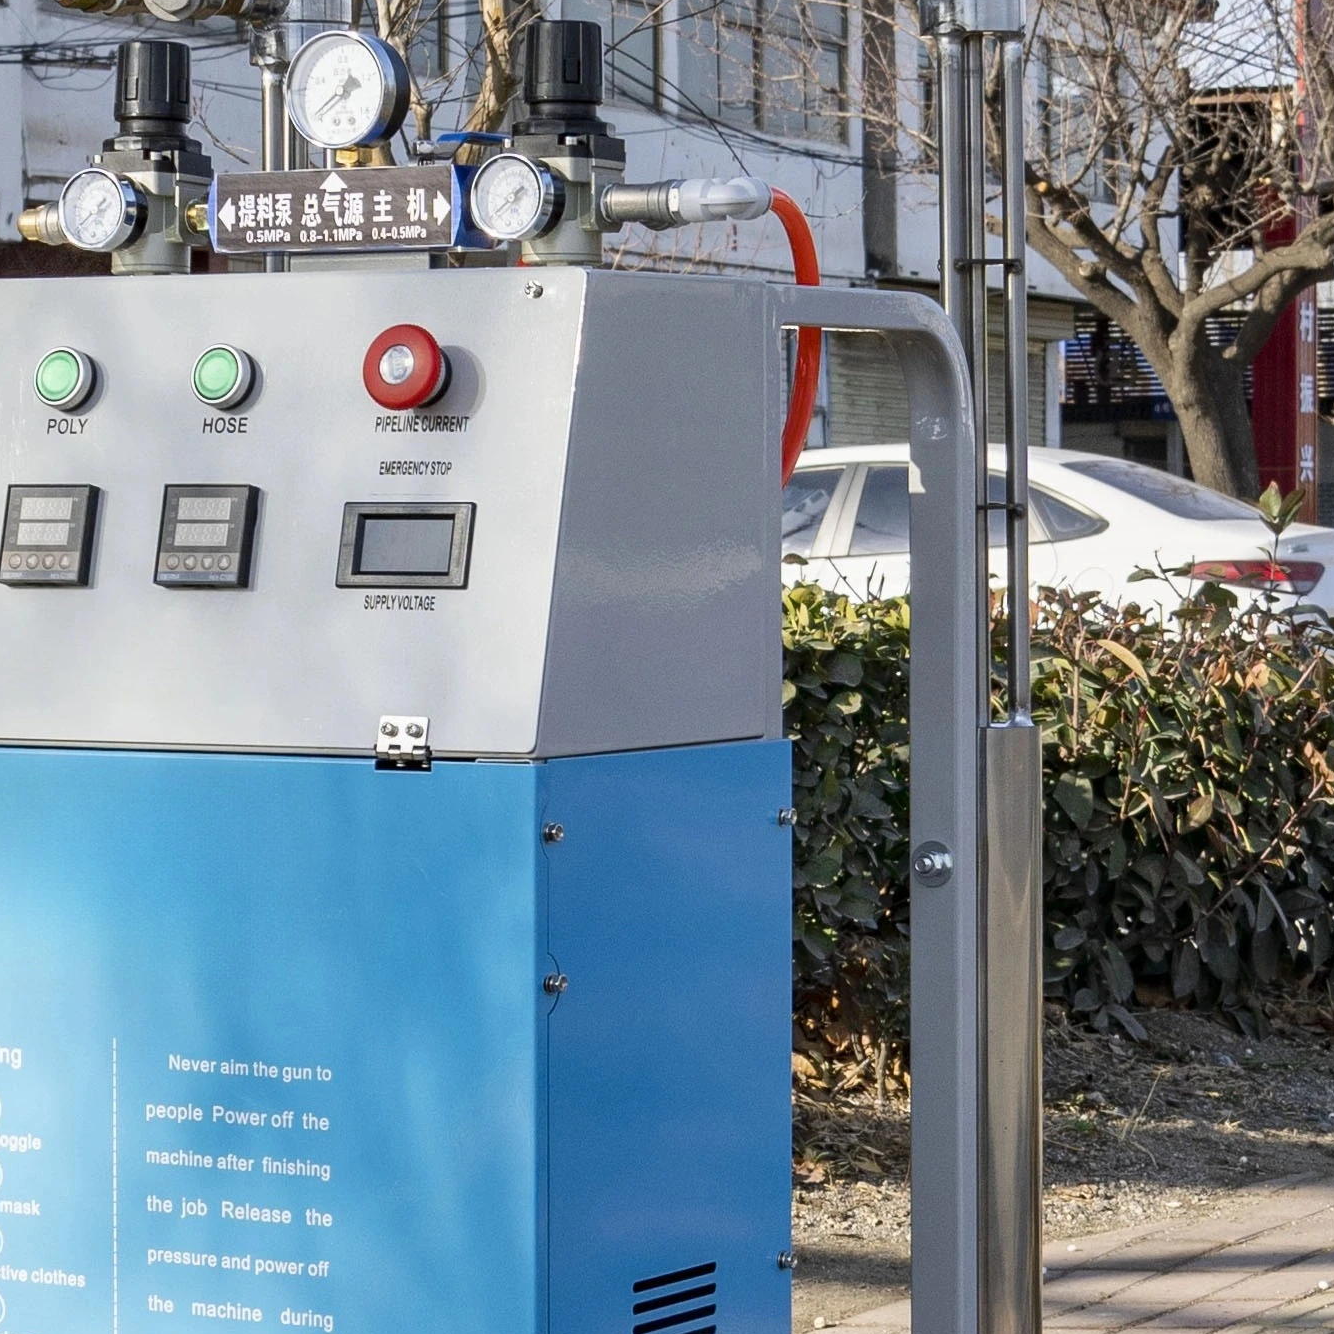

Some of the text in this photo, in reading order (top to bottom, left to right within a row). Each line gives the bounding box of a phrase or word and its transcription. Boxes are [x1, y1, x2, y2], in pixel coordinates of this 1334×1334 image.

[238, 193, 293, 228] 提料泵
[300, 192, 365, 228] 总气源
[245, 225, 428, 244] 0.5MPa 0.8-1.1MPa 0.4-0.5MPa
[46, 418, 89, 435] POLY
[202, 417, 249, 434] HOSE
[375, 415, 469, 433] PIPELINE CURRENT
[379, 460, 452, 476] EMERGENCY STOP
[363, 594, 436, 611] SUPPLY VOLTAGE
[168, 1054, 333, 1083] Never aim the gun to
[145, 1103, 330, 1131] people Power off the
[146, 1149, 332, 1181] machine after finishing
[0, 1199, 41, 1216] mask
[146, 1194, 334, 1227] the job Release the
[147, 1248, 331, 1278] pressure and power off
[30, 1268, 87, 1288] clothes
[147, 1294, 335, 1333] the machine during
